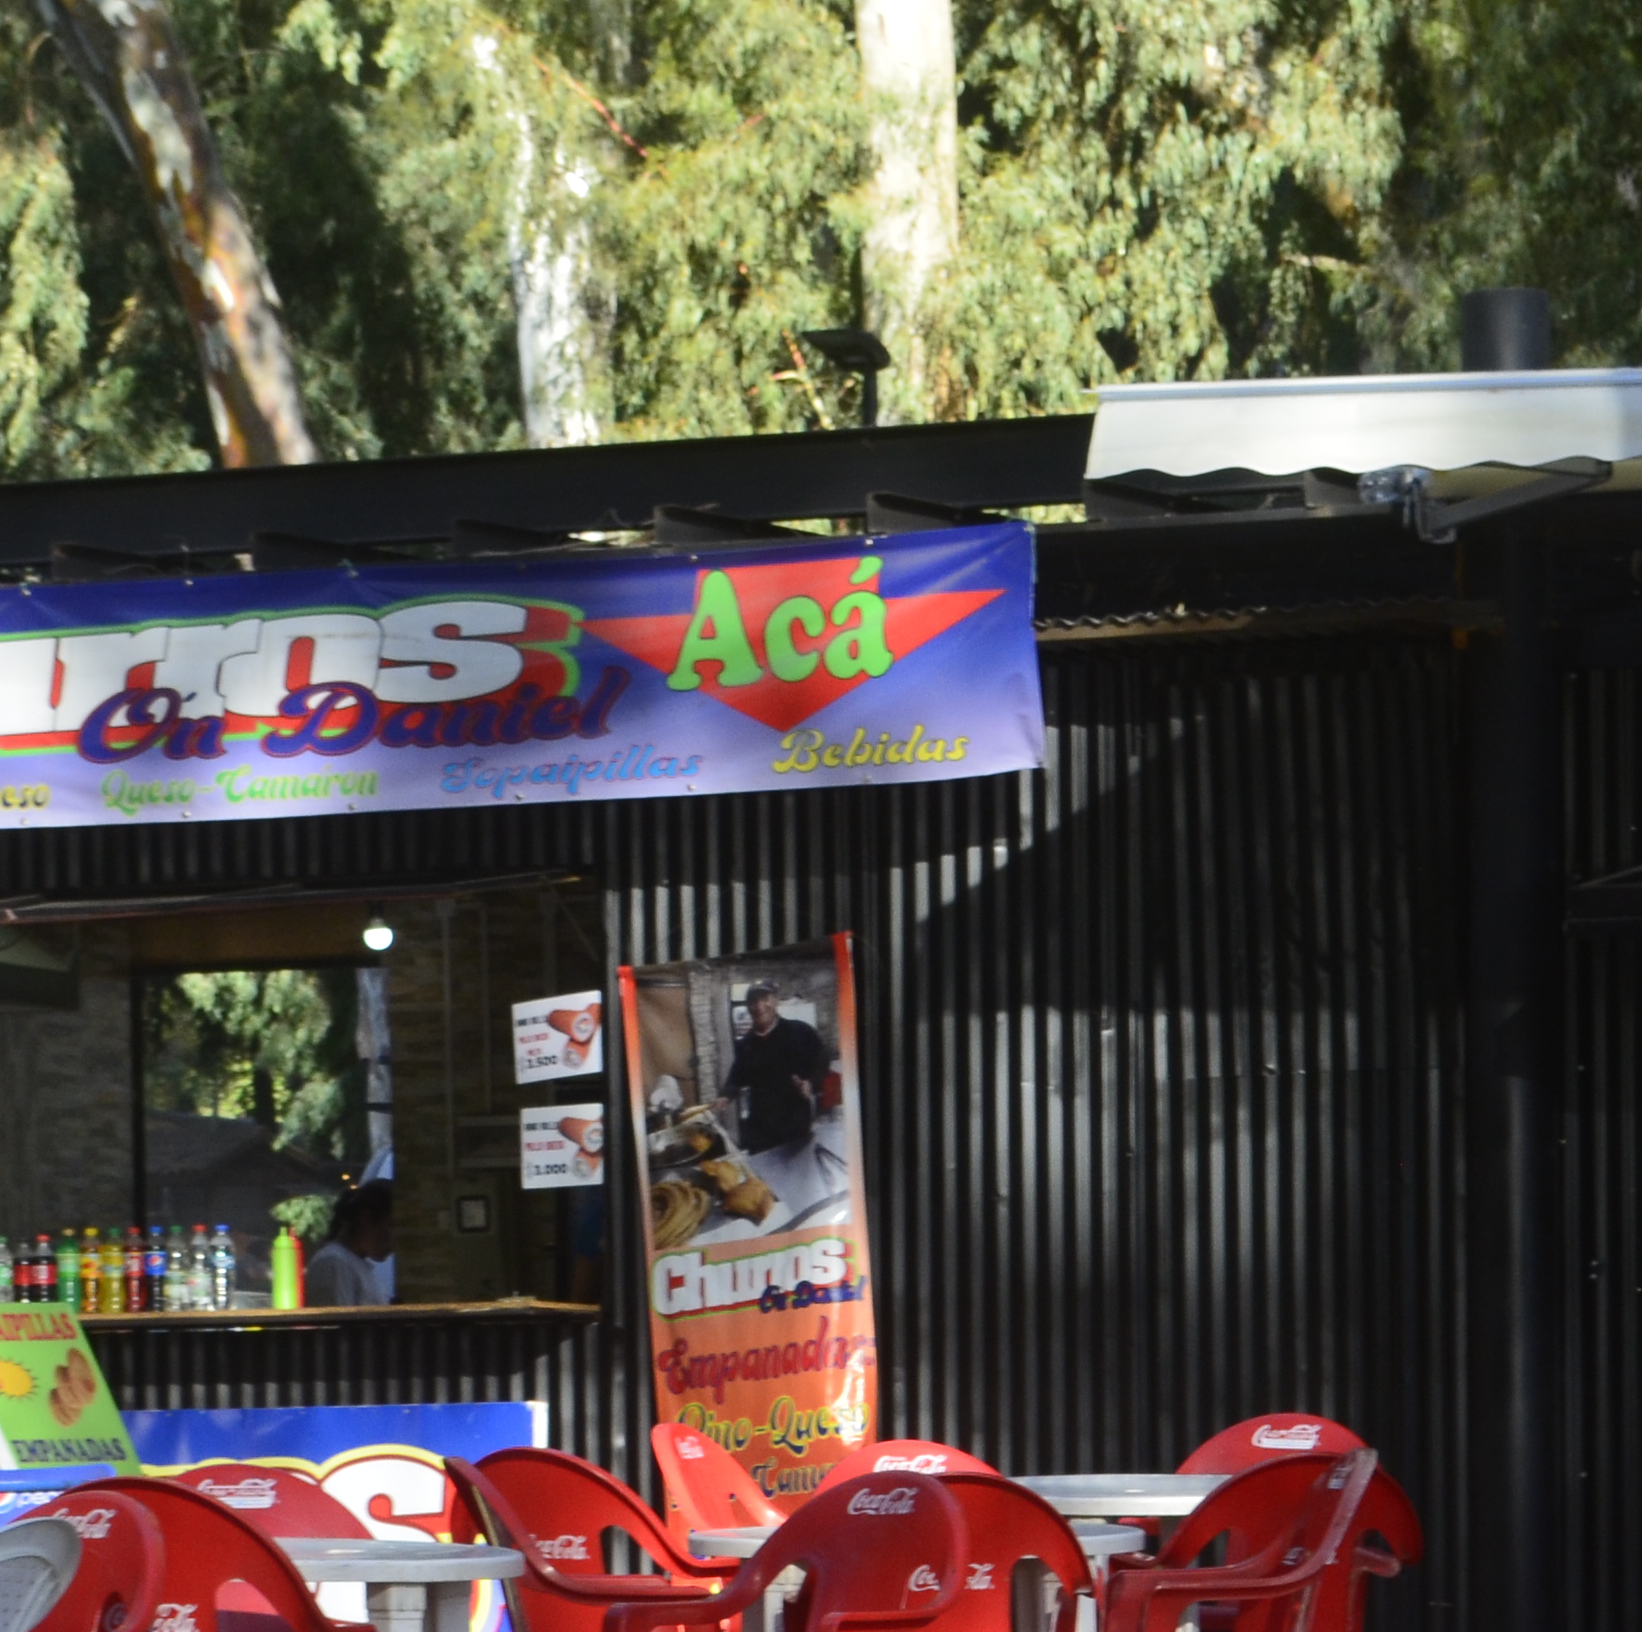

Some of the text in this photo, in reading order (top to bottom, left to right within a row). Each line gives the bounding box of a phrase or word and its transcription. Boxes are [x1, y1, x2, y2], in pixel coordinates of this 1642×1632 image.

[666, 556, 894, 692] Acá
[260, 665, 630, 760] Daniel
[441, 744, 703, 799] Sopaipillas
[772, 724, 970, 774] Bebidas
[650, 1237, 859, 1321] Churros
[10, 1438, 127, 1464] EMPANADAS
[847, 1487, 920, 1516] Coca-Cola
